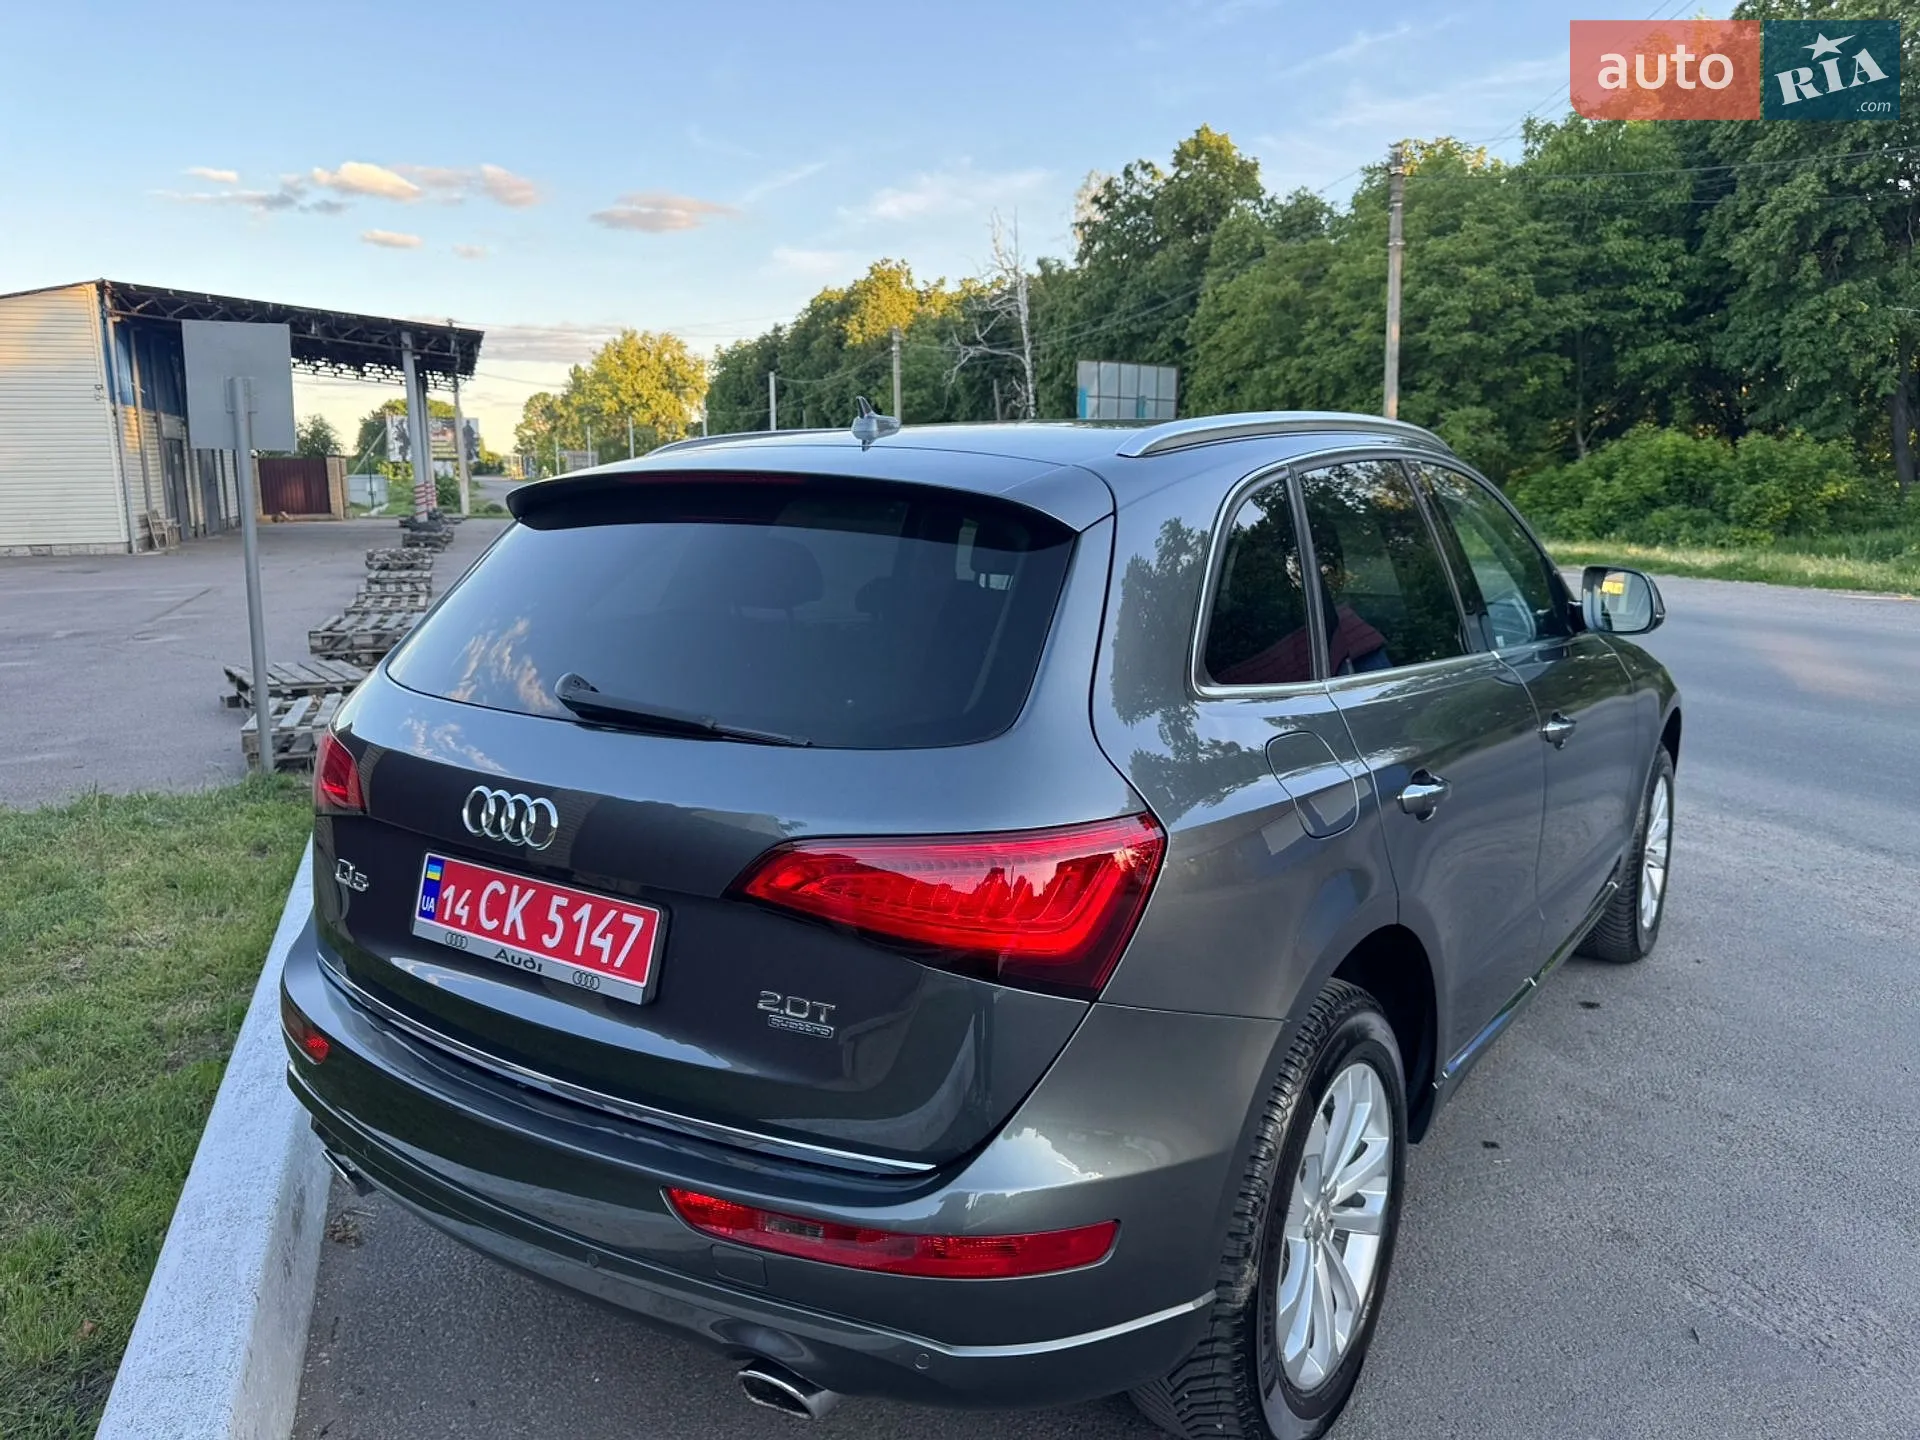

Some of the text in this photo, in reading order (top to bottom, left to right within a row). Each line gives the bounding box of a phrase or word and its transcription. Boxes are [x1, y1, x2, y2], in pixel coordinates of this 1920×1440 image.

[335, 858, 369, 892] Q5
[421, 895, 435, 913] UA
[542, 895, 644, 968] 5147
[494, 949, 543, 973] Audi
[757, 990, 836, 1023] 2.0T
